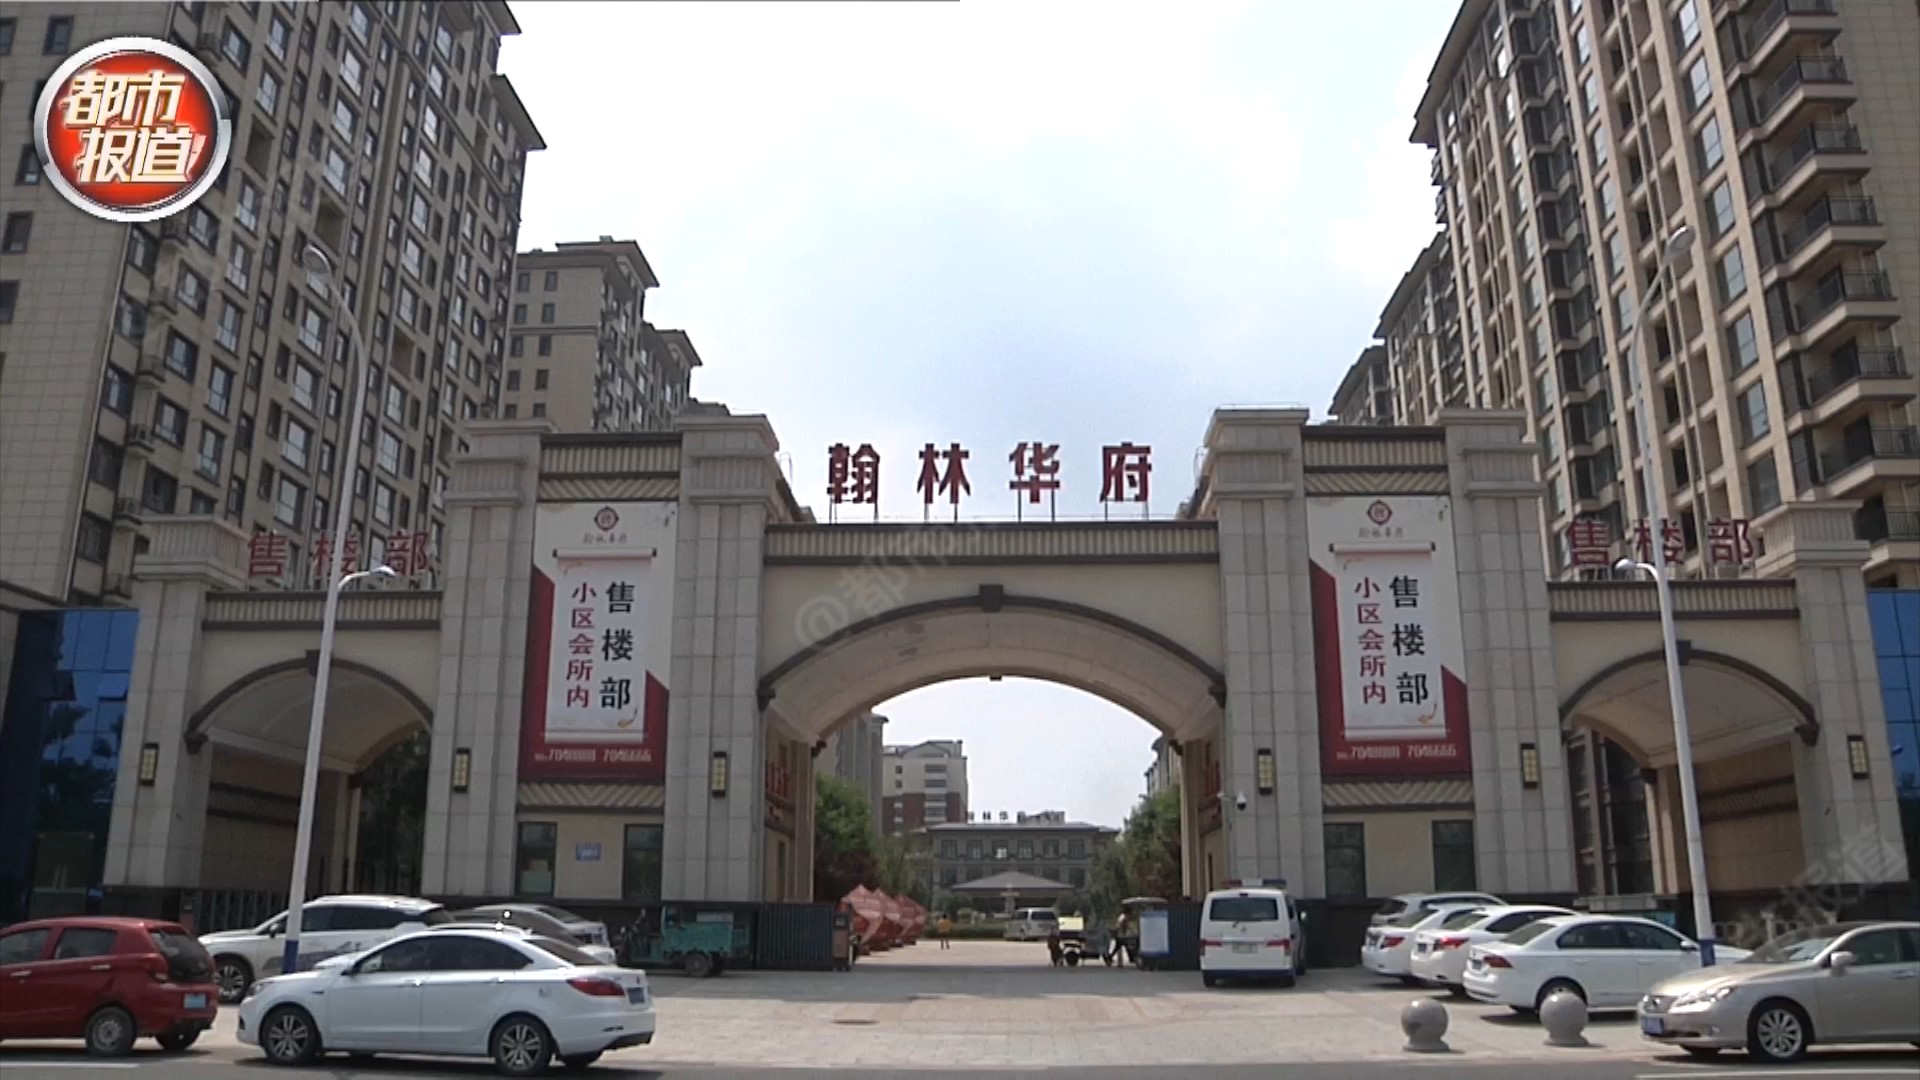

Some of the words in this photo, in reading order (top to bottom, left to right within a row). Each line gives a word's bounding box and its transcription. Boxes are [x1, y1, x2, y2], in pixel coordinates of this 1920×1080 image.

[826, 442, 1153, 504] 翰林华府
[248, 529, 430, 579] 售楼部
[1567, 516, 1755, 569] 售楼部
[566, 581, 597, 709] 小区会所内
[599, 581, 635, 710] 售楼部
[1354, 576, 1387, 705] 小区会所内
[1388, 575, 1429, 706] 售楼部
